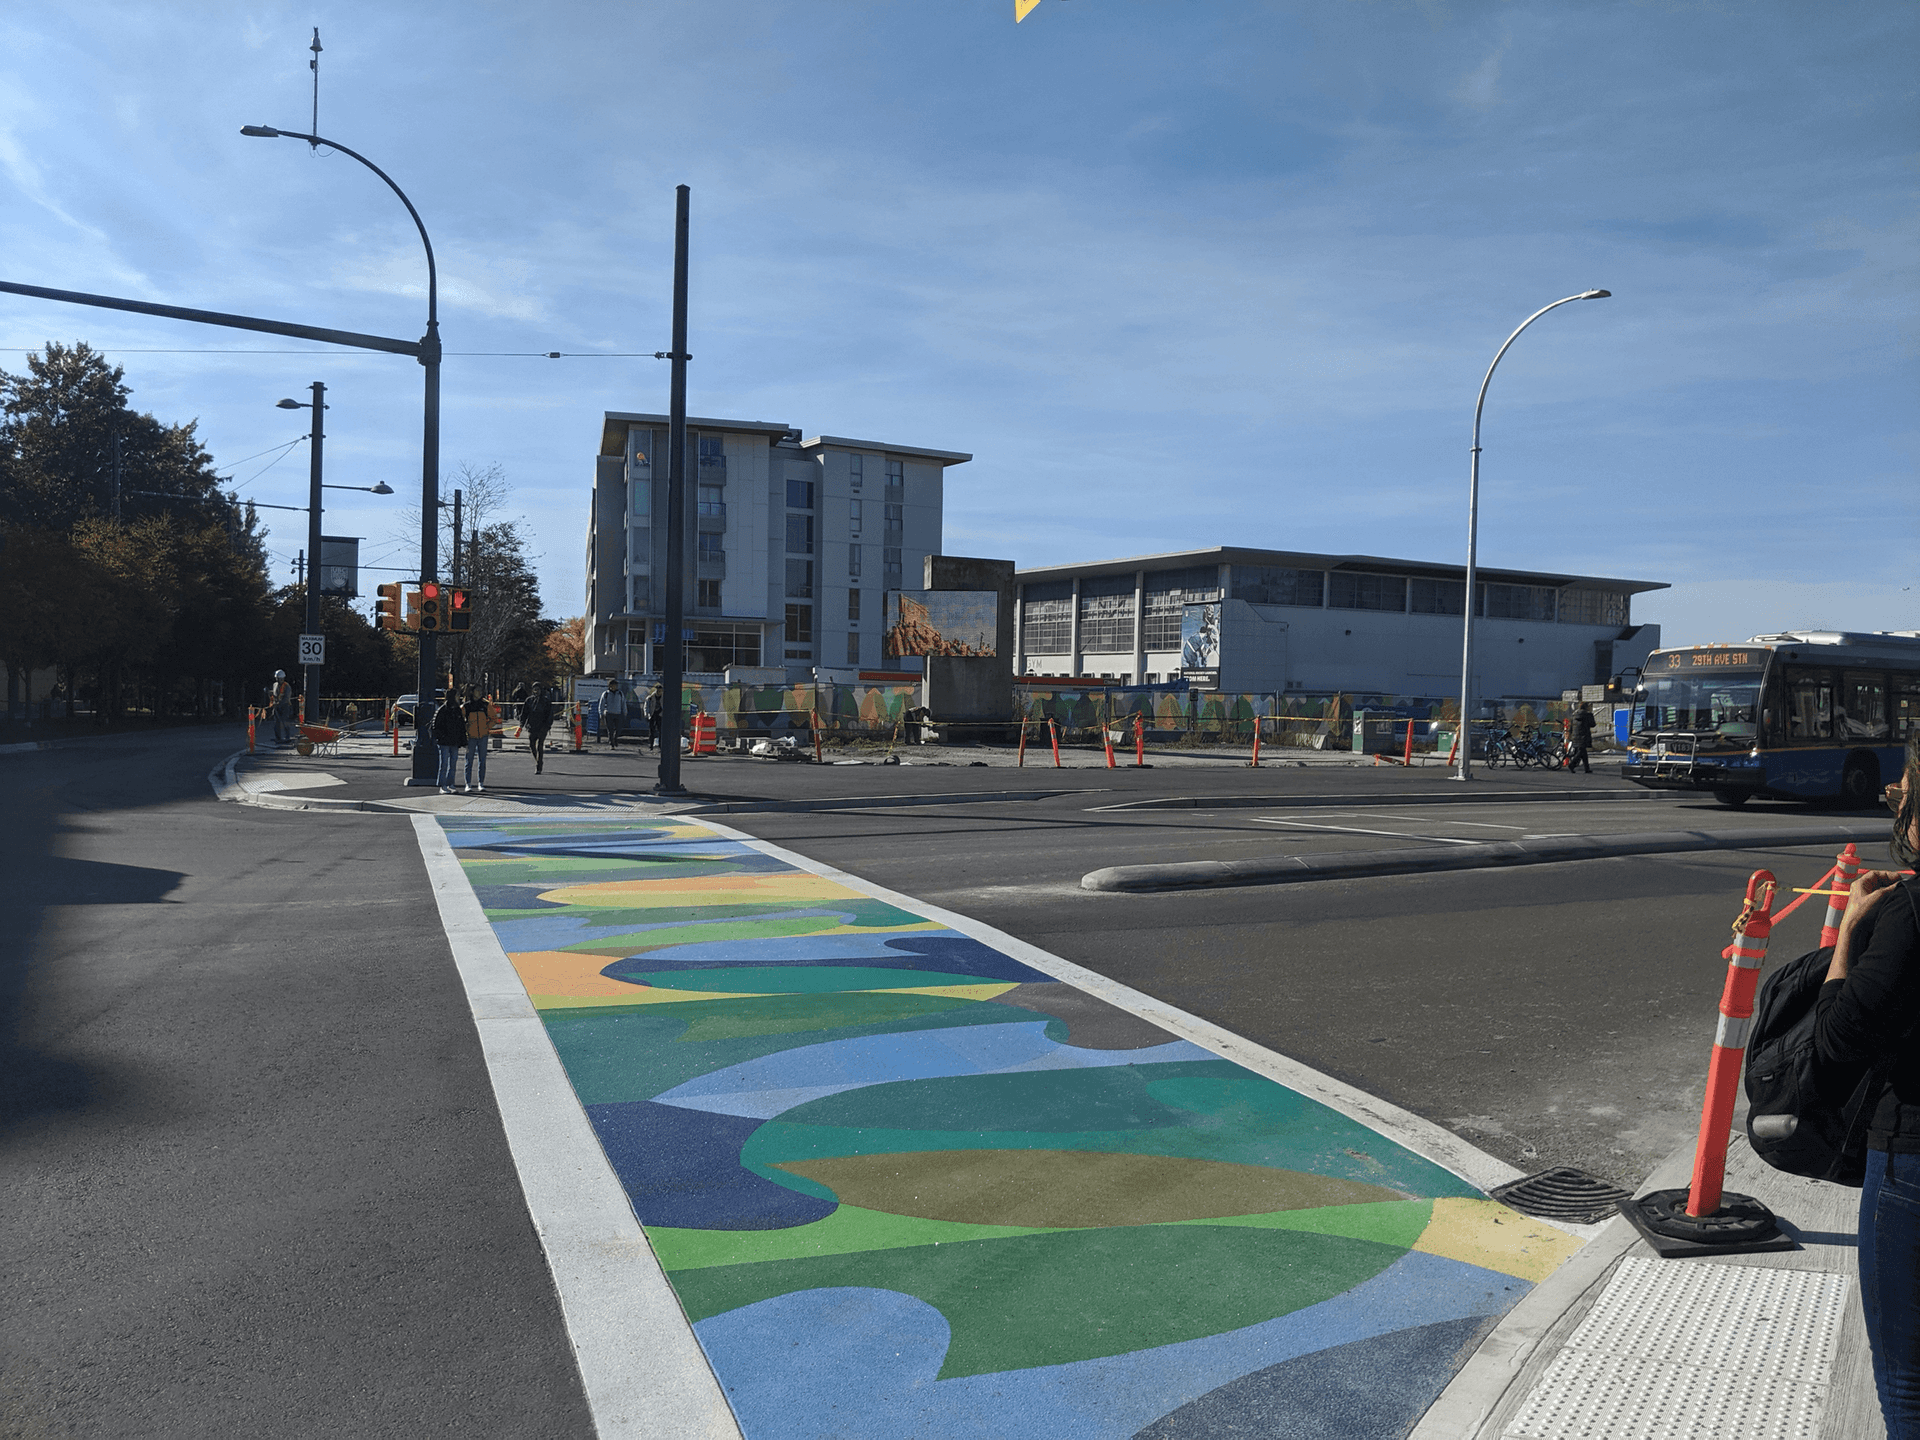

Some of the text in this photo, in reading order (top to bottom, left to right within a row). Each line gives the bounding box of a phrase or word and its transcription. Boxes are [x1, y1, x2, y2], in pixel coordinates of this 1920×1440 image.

[302, 641, 322, 655] 30
[1668, 652, 1748, 668] 33 29TH AVE STN
